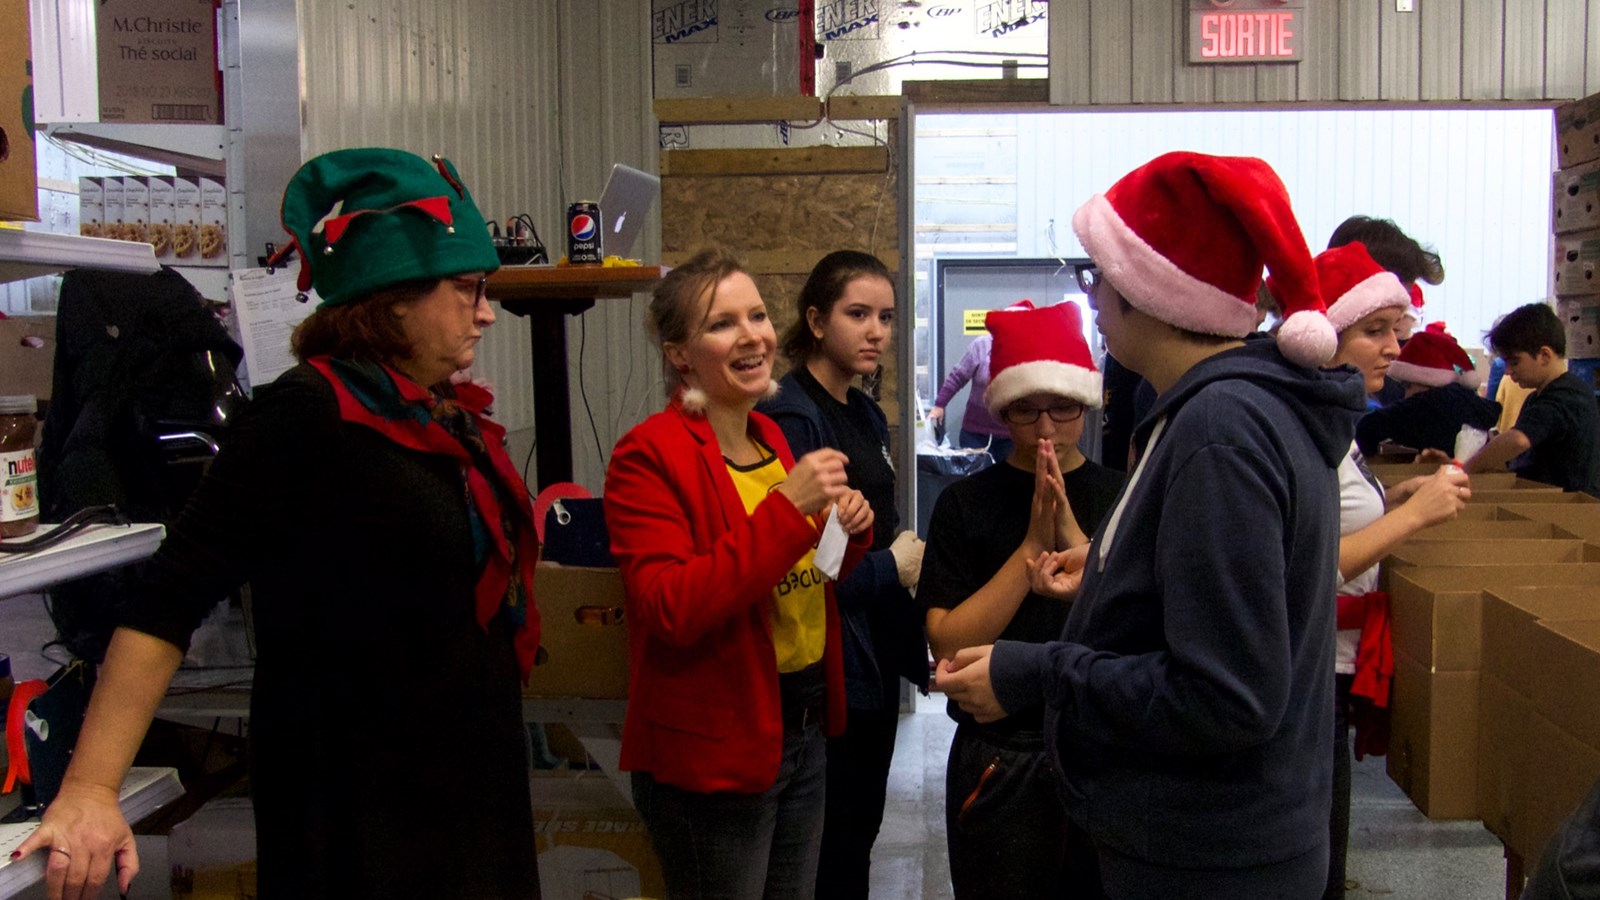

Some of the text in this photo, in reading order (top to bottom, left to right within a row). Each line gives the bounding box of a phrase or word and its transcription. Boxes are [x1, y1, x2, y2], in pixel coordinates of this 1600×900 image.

[112, 17, 203, 33] M.Christie
[666, 16, 718, 43] MAX
[826, 14, 878, 40] MAX
[1201, 13, 1293, 57] SORTIE
[119, 46, 197, 61] Thé social
[573, 242, 595, 251] pepsi
